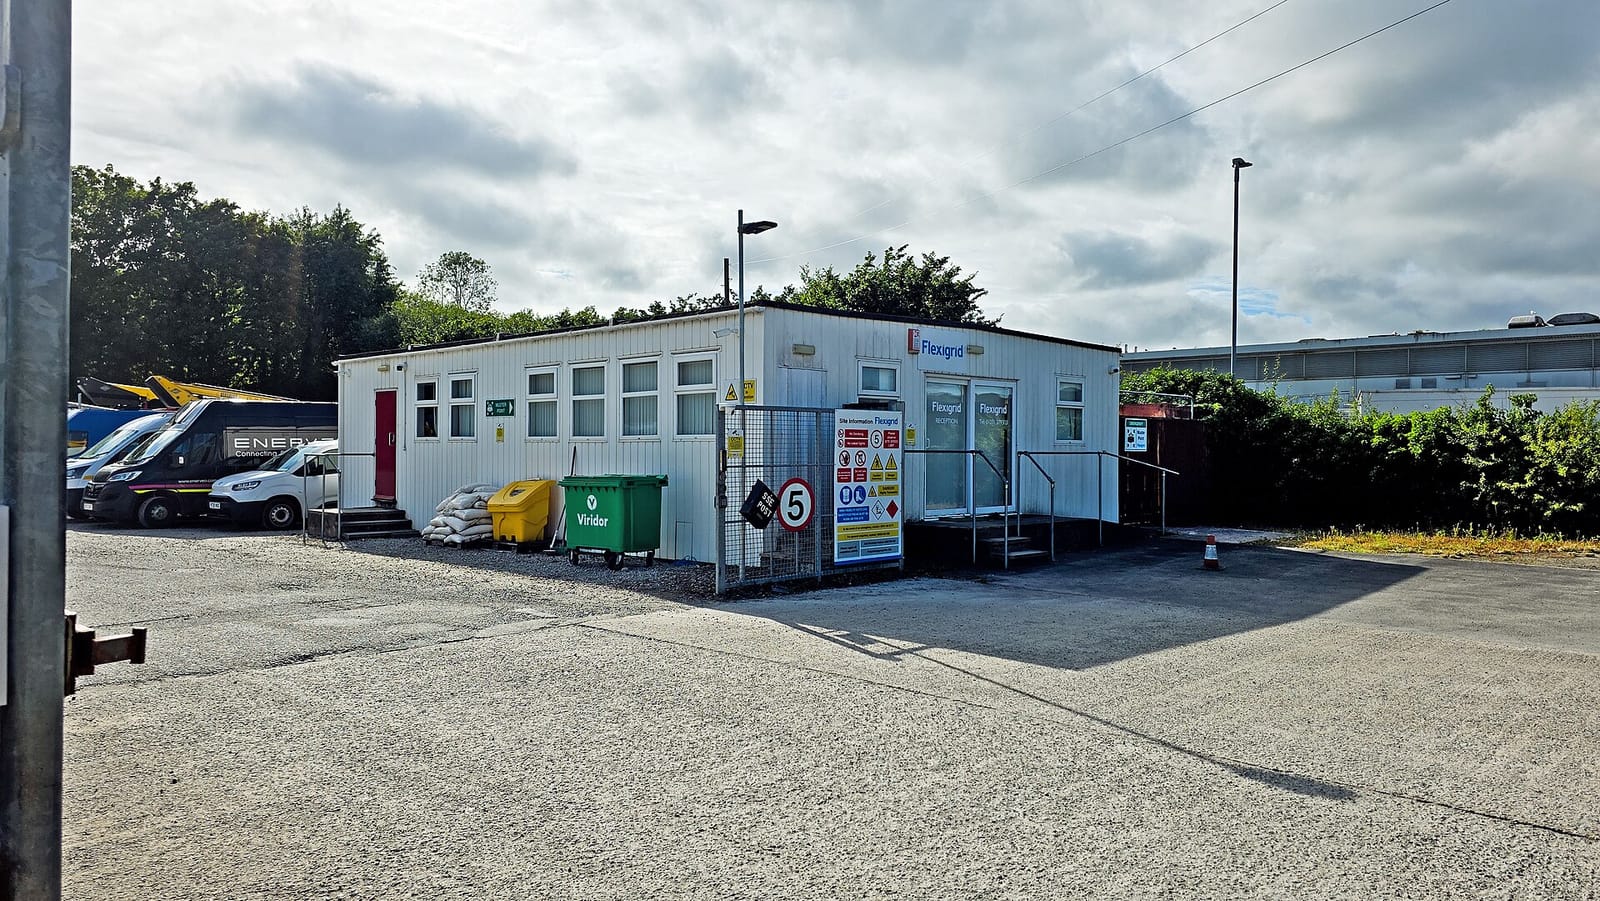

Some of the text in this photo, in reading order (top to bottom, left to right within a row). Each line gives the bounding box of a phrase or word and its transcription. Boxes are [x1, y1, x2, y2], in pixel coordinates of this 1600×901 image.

[921, 340, 963, 360] Flexigrid
[932, 401, 961, 414] Flexigrid
[979, 403, 1007, 416] Flexigrid
[874, 417, 898, 426] Flexigrid
[234, 438, 334, 448] ENER
[874, 434, 880, 444] 5
[762, 492, 775, 507] SSE
[787, 490, 804, 521] 5
[757, 500, 772, 518] POST
[577, 513, 609, 527] Viridor
